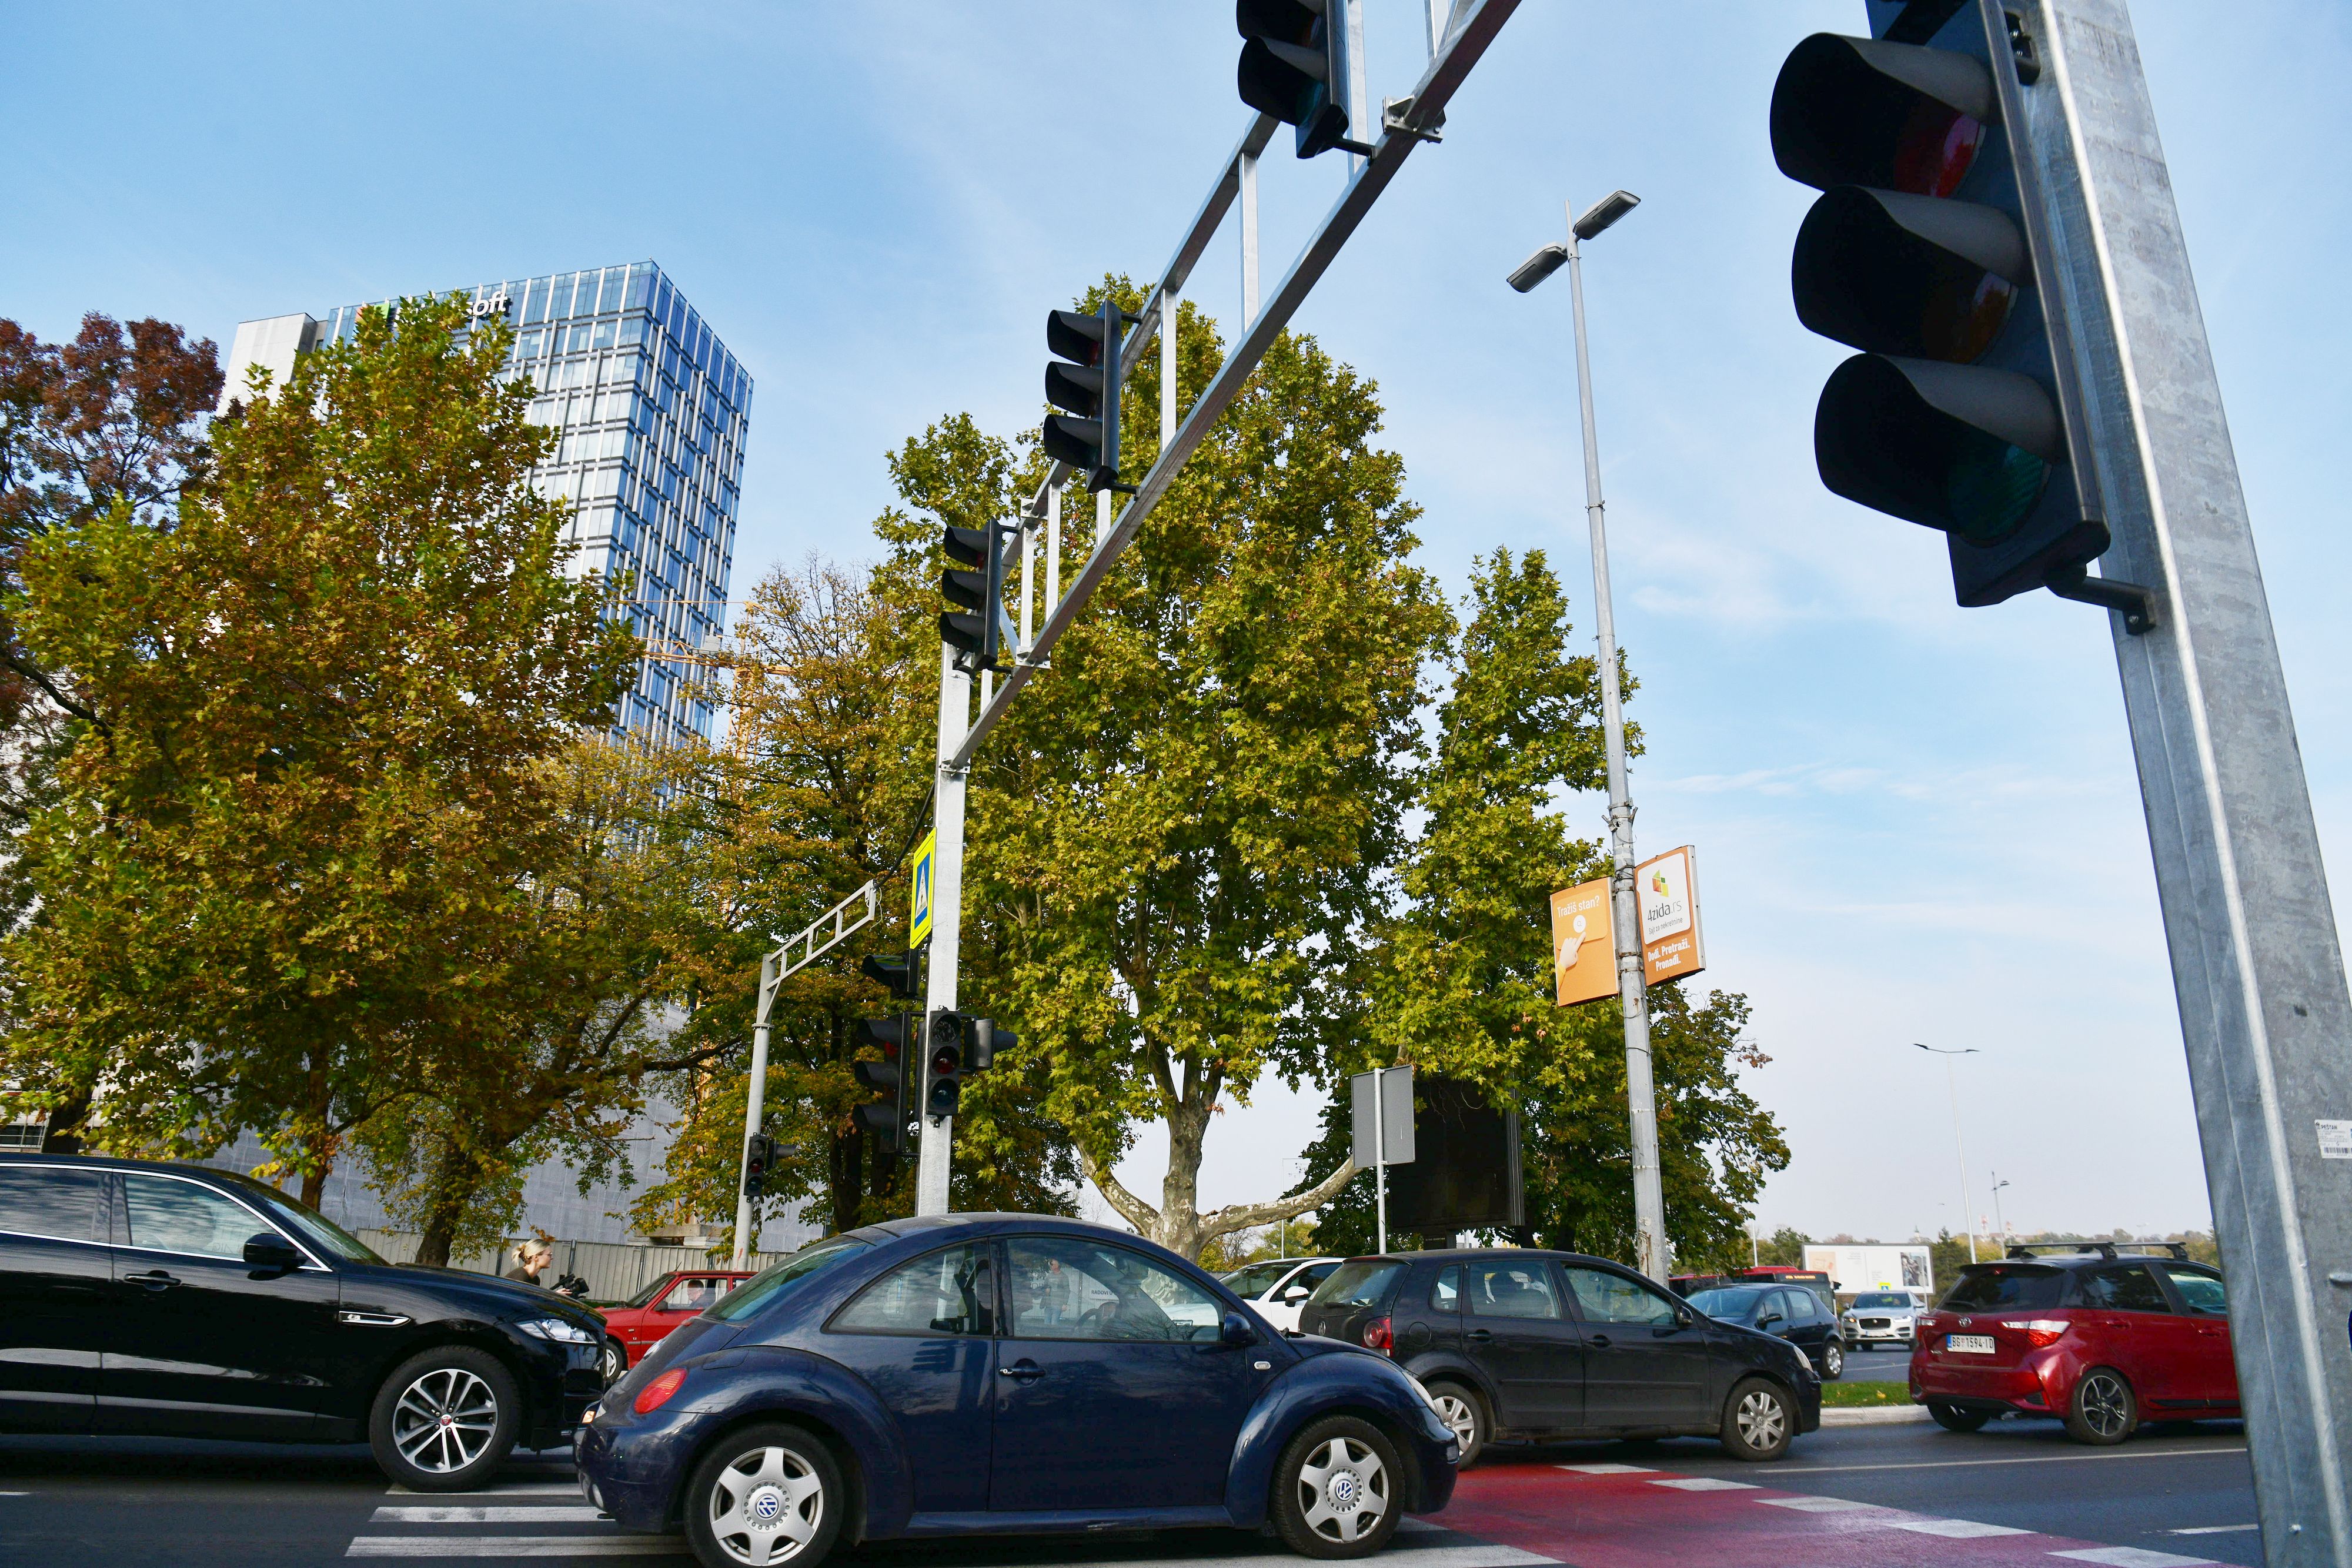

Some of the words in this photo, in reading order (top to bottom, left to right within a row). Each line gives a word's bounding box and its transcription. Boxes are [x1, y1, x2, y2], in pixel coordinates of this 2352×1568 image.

[1557, 901, 1577, 918] Tražiš
[1578, 895, 1600, 911] stan?
[1648, 900, 1682, 922] 4zida.rs
[1661, 917, 1683, 930] nekretnine
[1661, 938, 1690, 957] Pretraži.
[1952, 1336, 1961, 1347] BG
